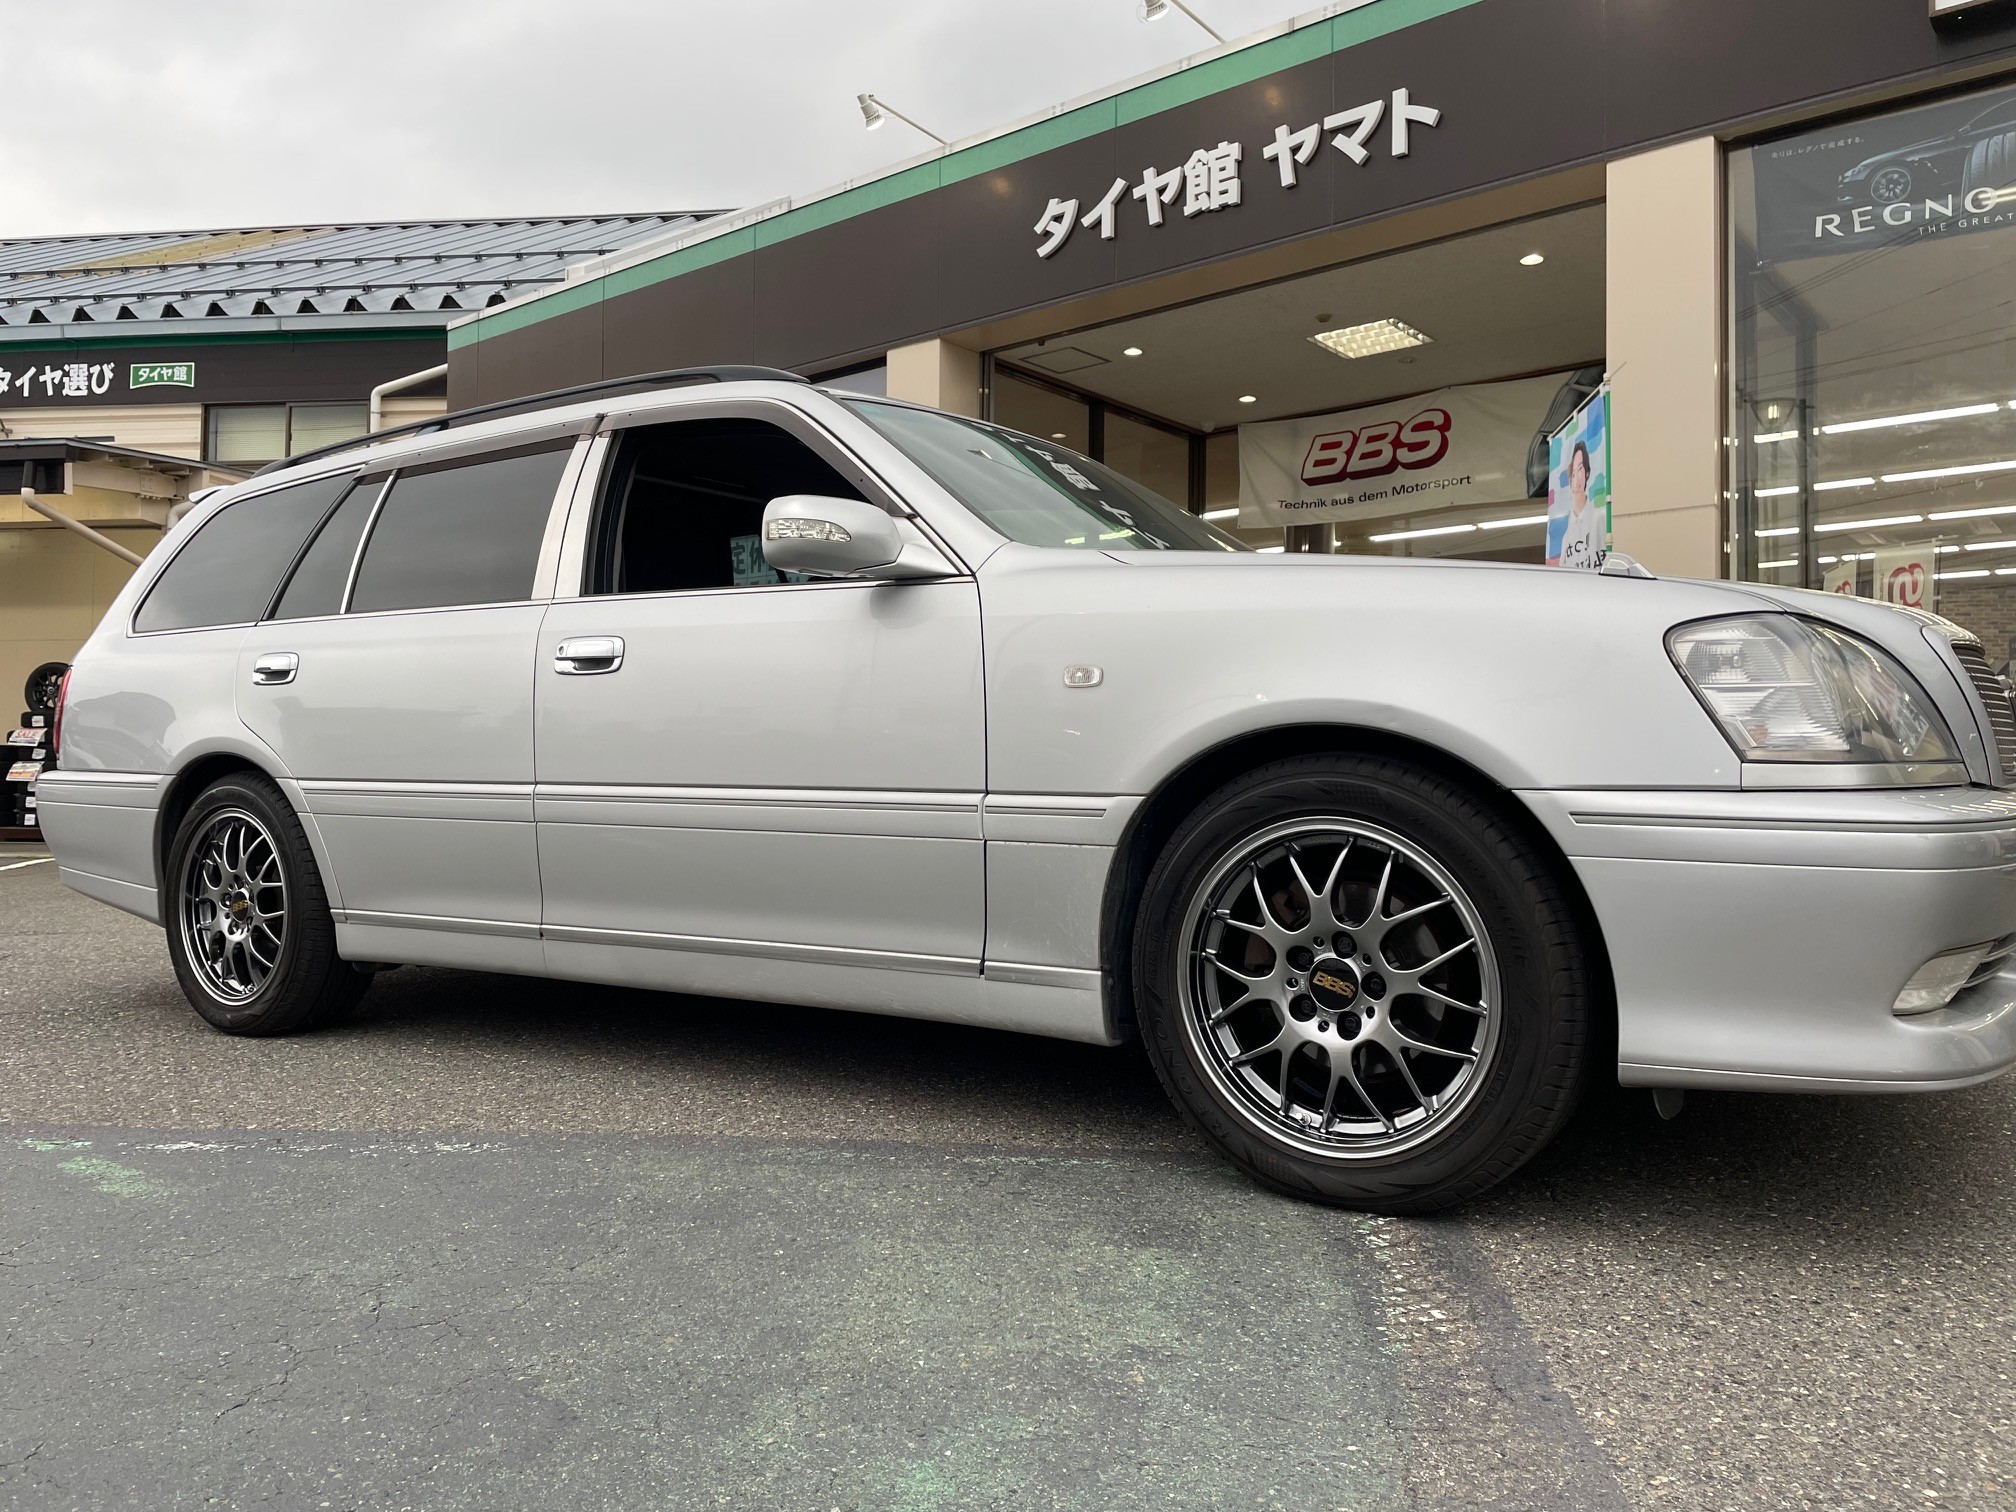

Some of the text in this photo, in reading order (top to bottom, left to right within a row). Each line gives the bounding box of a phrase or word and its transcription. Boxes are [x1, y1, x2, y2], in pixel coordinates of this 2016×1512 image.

[1033, 87, 1441, 258] タイヤ館 ヤマト
[1814, 187, 1997, 238] REGNO
[1918, 212, 2014, 235] THE GREAT
[138, 365, 188, 382] タイヤ館
[1300, 408, 1452, 486] BBS
[1278, 474, 1472, 510] Technik aus dem Motorsport
[732, 539, 775, 575] 定休
[1312, 971, 1356, 999] BBS
